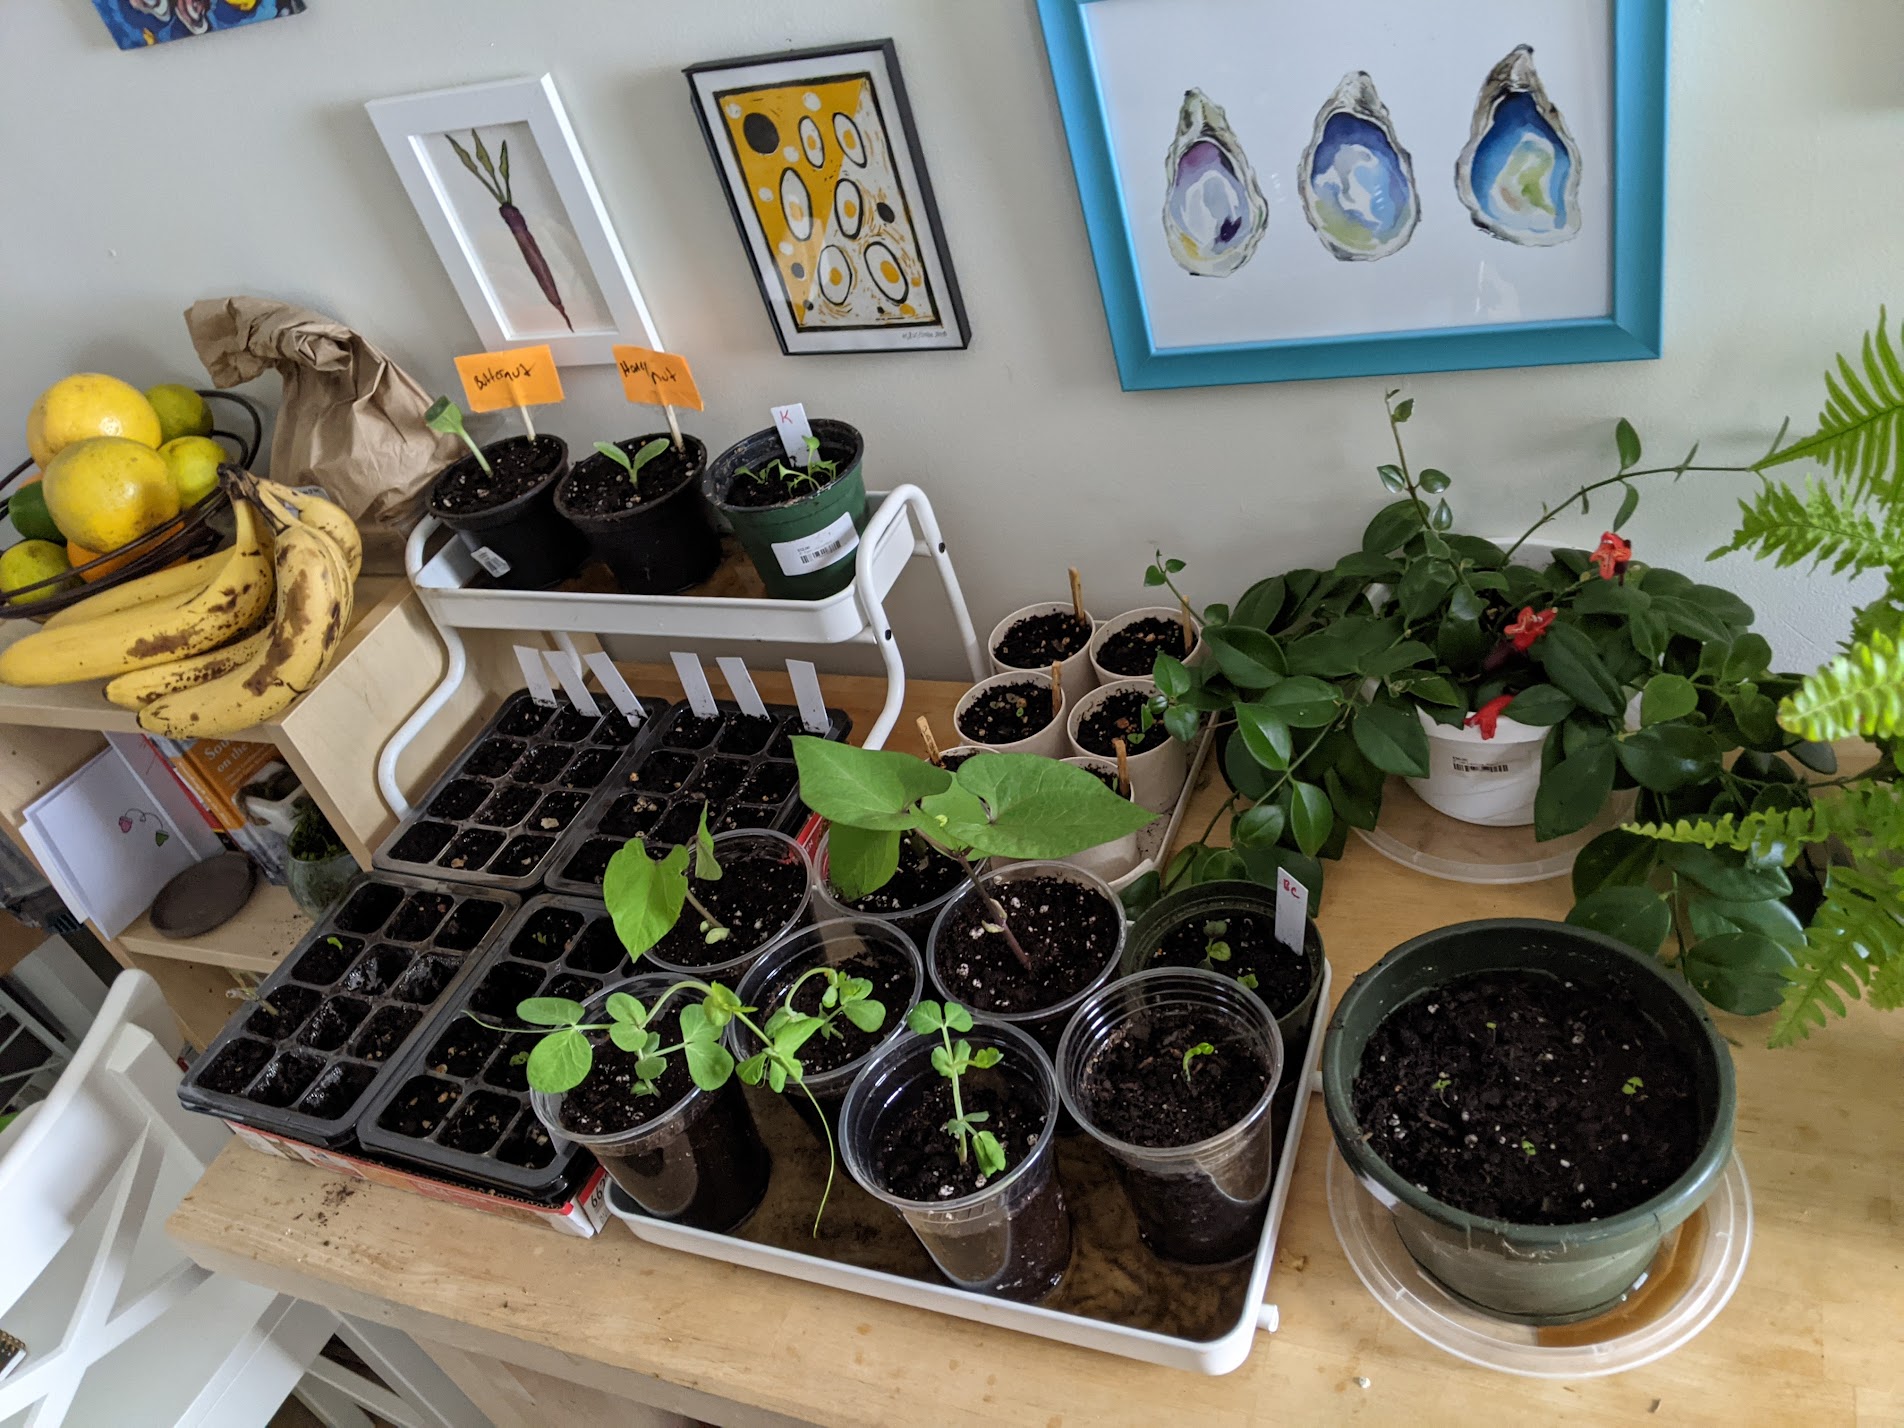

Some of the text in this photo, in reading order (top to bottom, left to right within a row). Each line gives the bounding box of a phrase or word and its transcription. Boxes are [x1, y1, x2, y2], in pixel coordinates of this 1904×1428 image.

[473, 362, 536, 391] Butternut
[779, 409, 793, 425] K
[217, 743, 249, 773] on the
